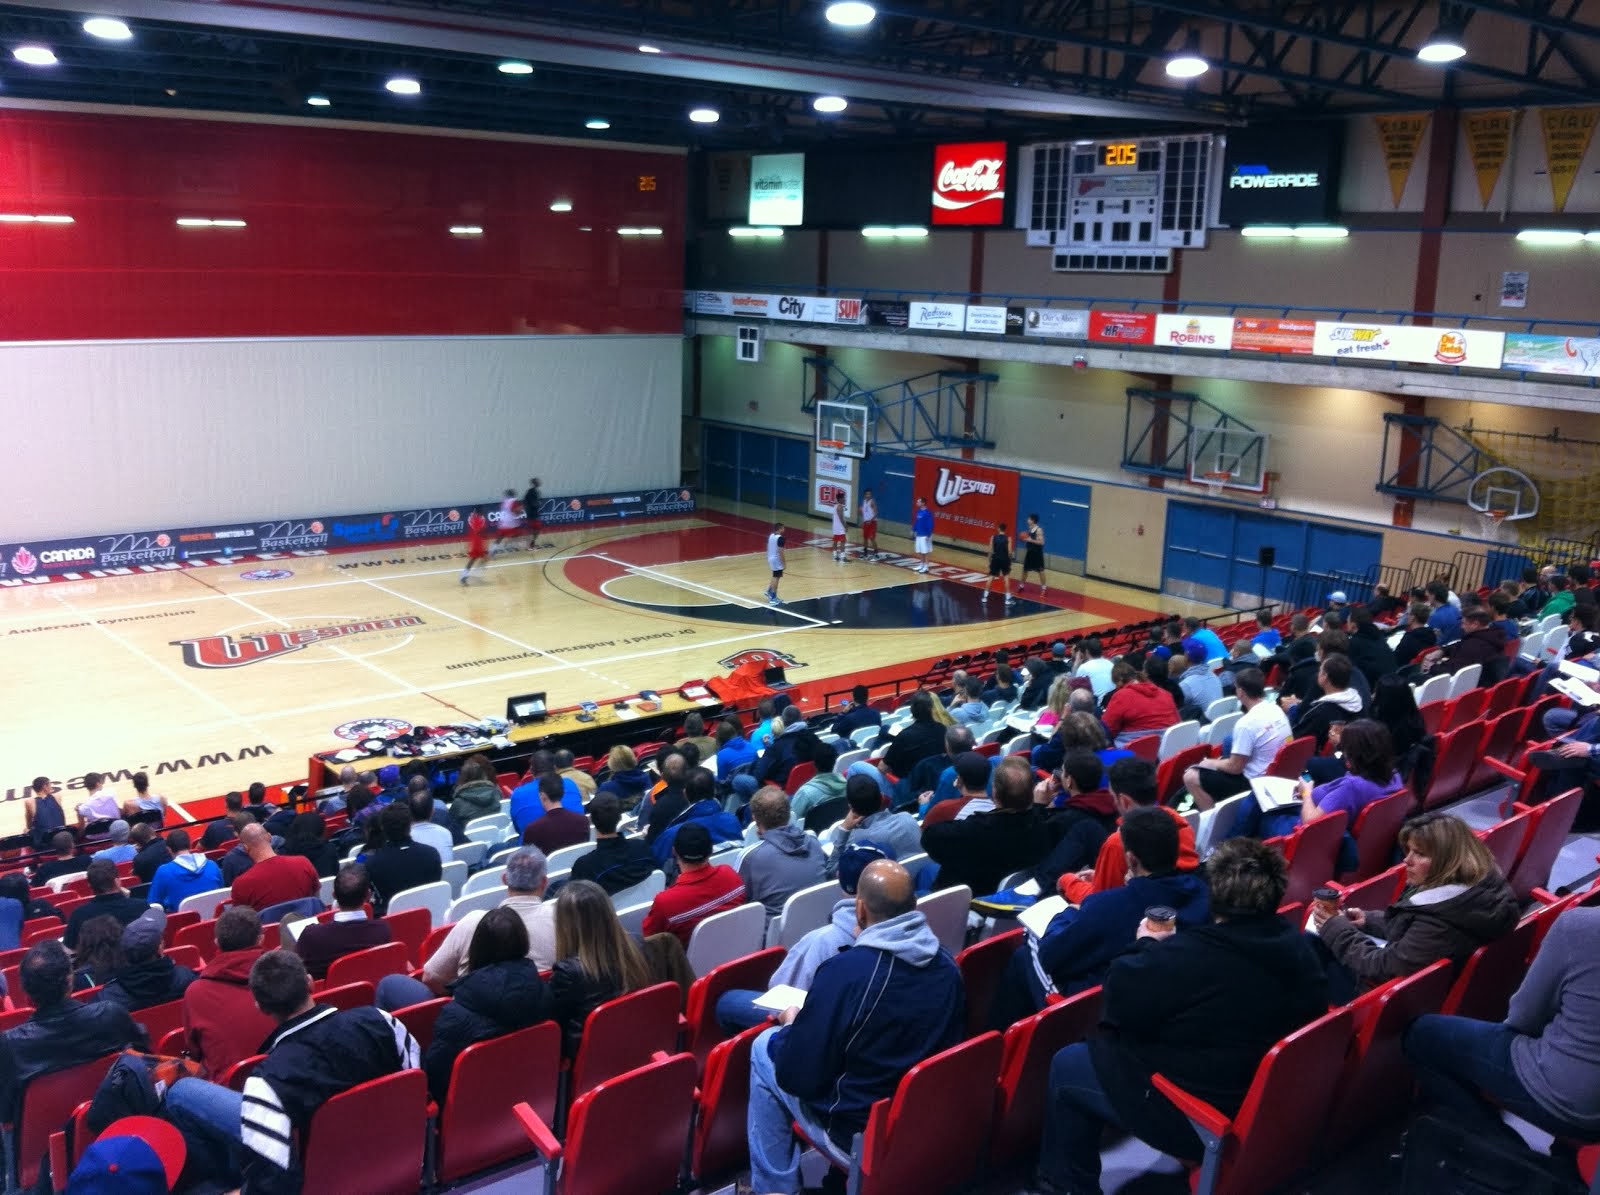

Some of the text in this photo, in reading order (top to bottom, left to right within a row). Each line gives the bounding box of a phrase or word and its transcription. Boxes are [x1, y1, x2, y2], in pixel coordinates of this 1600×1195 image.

[938, 159, 1003, 192] Coca-Cola
[1230, 172, 1319, 189] POWERADE
[779, 296, 806, 319] City
[838, 299, 860, 319] SUN
[1169, 330, 1216, 346] ROBIN'S
[1329, 327, 1382, 342] SUBWAY
[1337, 346, 1353, 355] eat
[404, 519, 464, 536] Basketball
[260, 532, 328, 549] Basketball
[39, 546, 96, 563] CANADA
[100, 546, 176, 563] Basketball
[8, 608, 196, 635] Anderson Gymnasium
[633, 630, 676, 643] David
[545, 639, 616, 655] Anderson
[445, 650, 544, 671] Gymnasium
